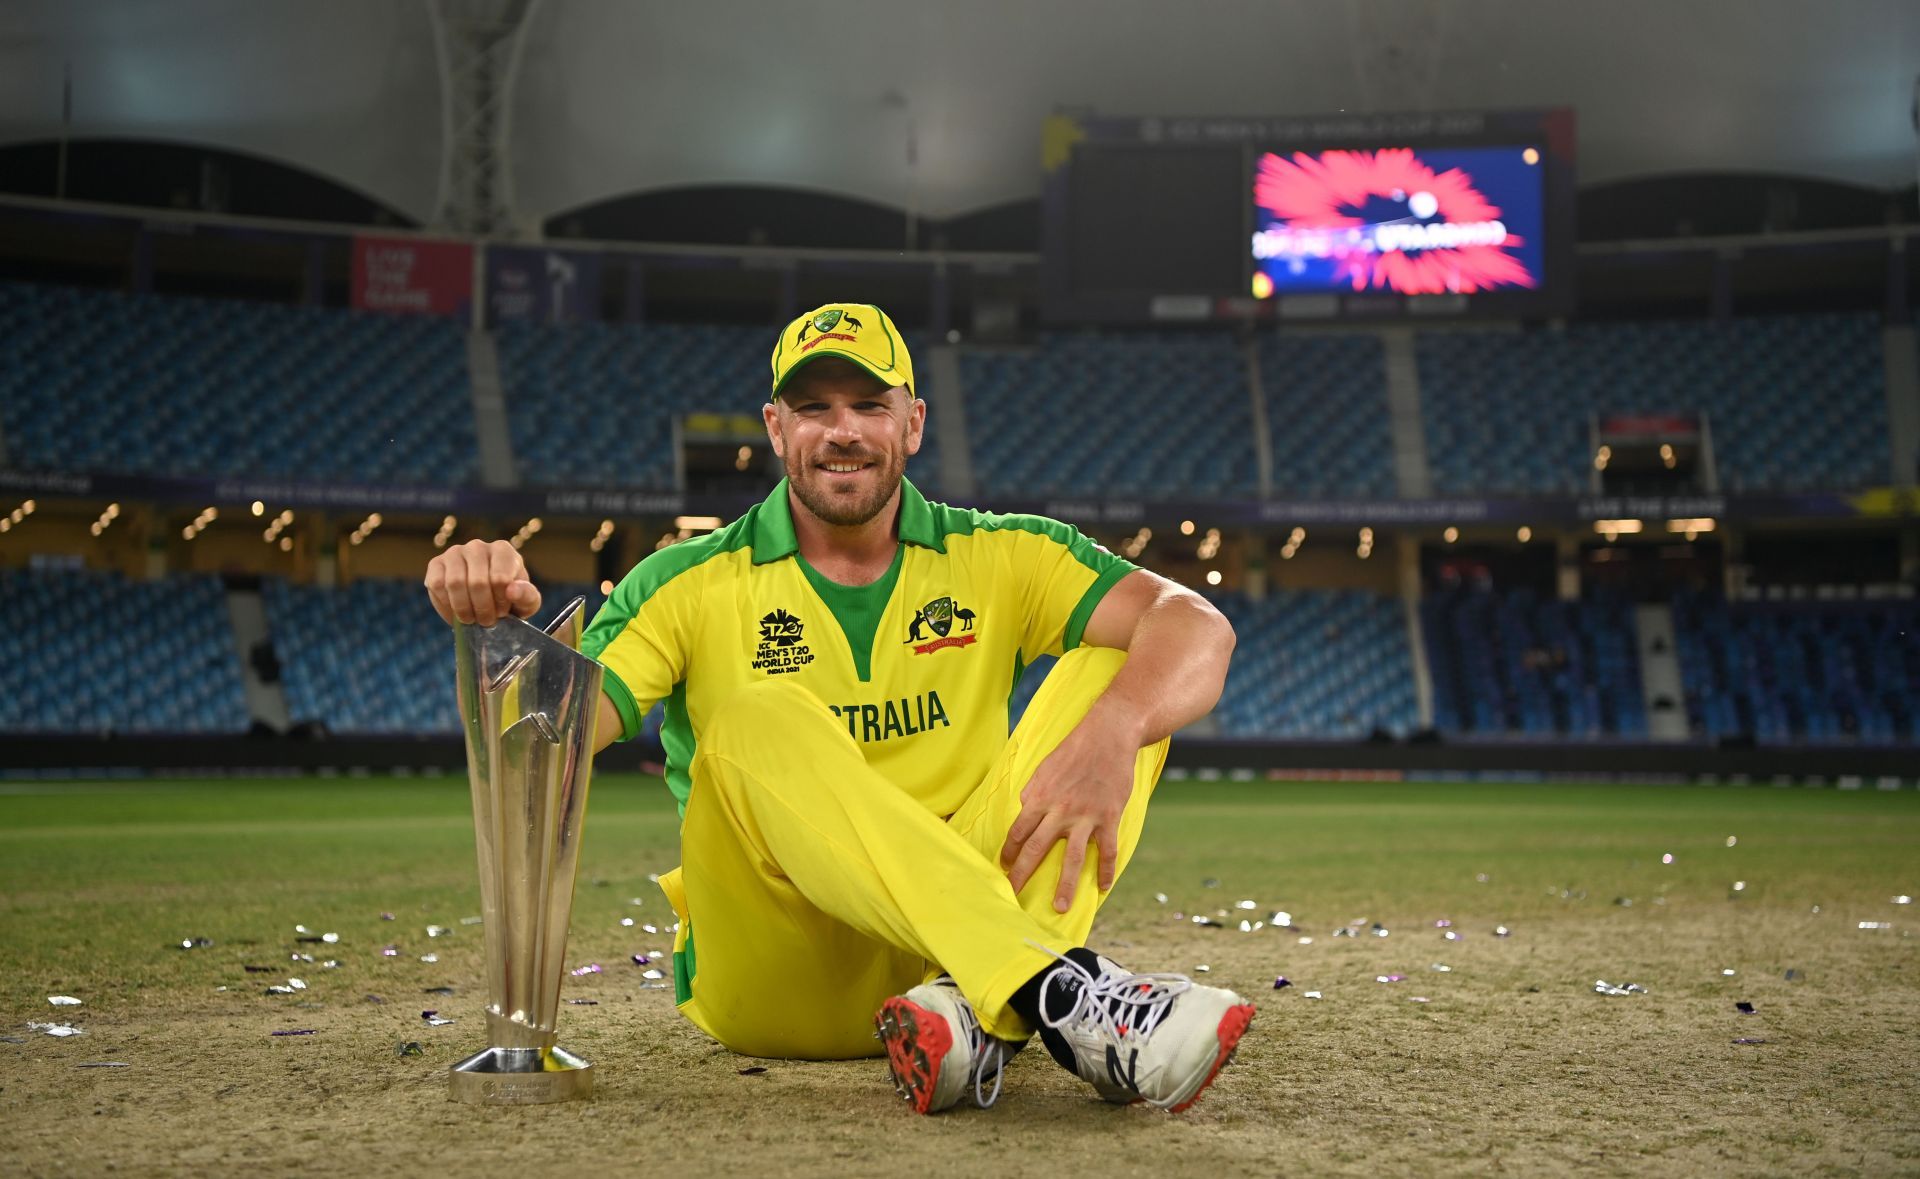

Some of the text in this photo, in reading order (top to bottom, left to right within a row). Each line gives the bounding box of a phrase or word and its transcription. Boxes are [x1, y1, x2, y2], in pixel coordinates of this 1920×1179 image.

[756, 646, 809, 659] MEN'S T20
[758, 642, 771, 650] ICC
[752, 654, 815, 669] WORLD CUP
[828, 690, 950, 742] TRALIA
